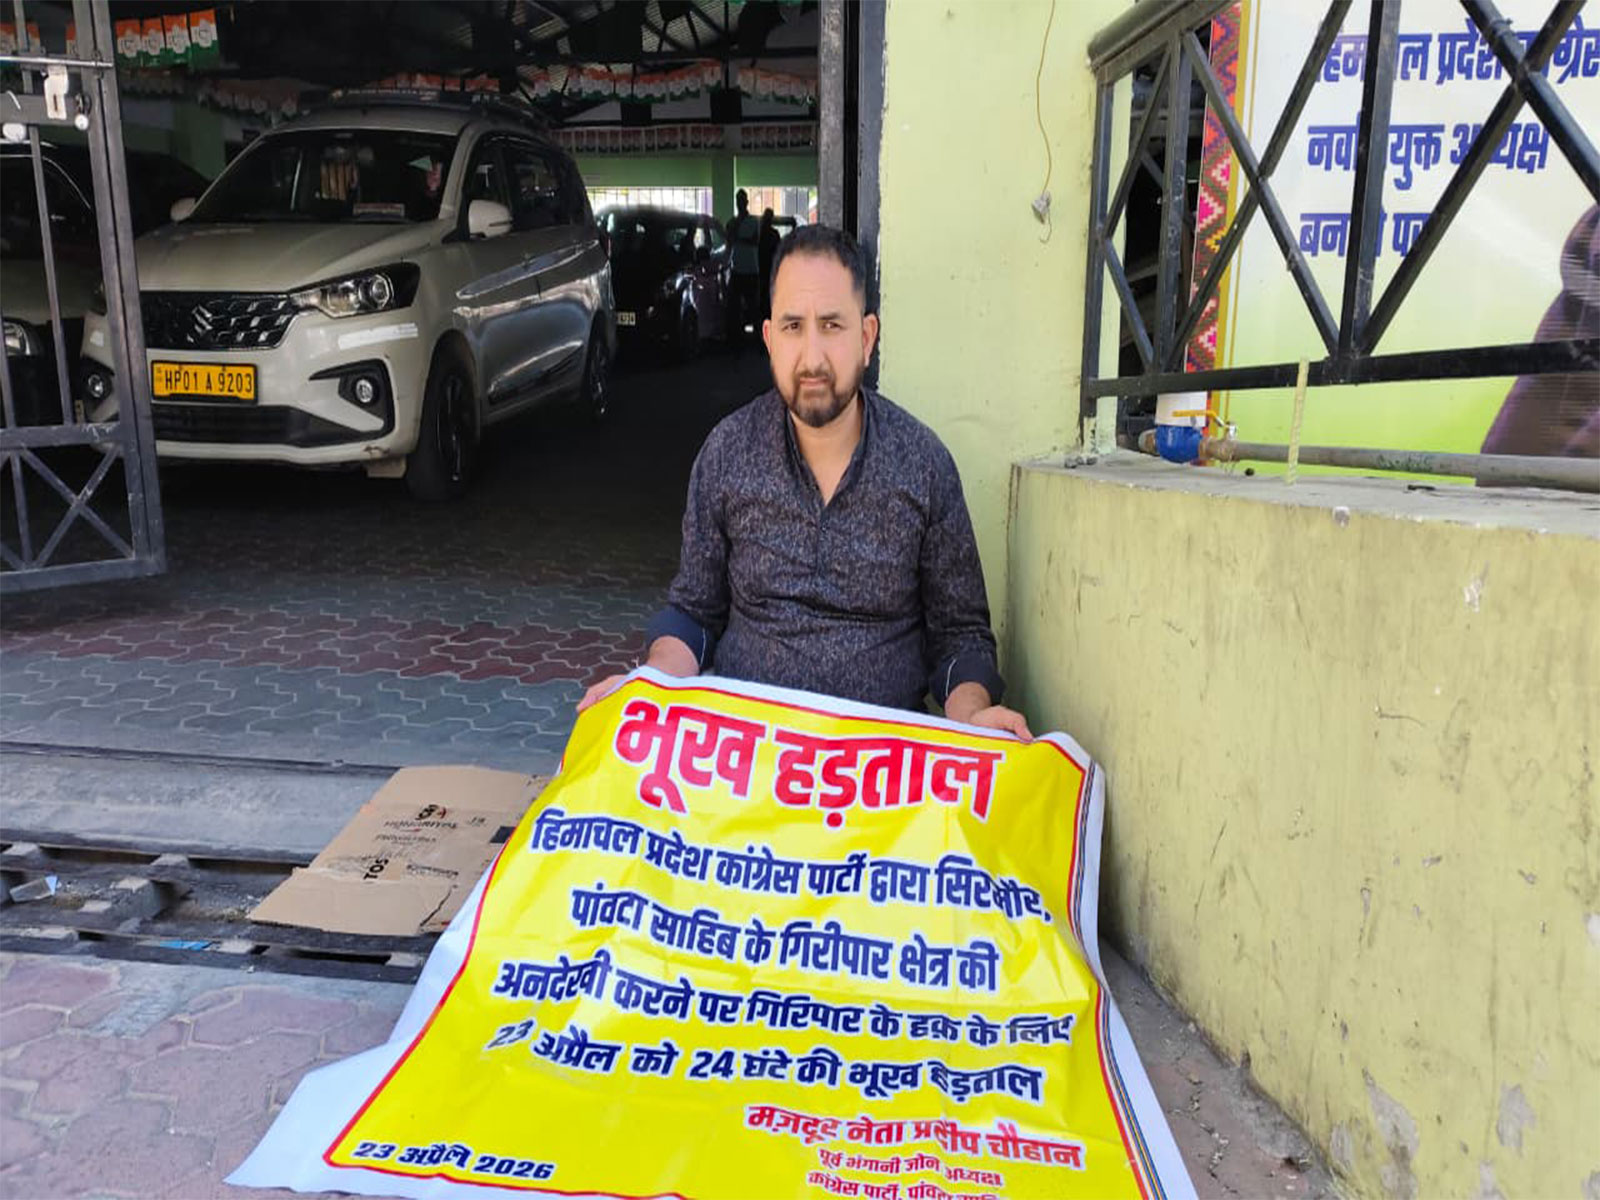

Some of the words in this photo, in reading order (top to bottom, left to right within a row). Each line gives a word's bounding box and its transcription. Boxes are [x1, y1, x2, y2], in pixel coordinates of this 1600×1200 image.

[165, 369, 198, 391] HP01
[206, 371, 213, 392] A
[218, 372, 253, 393] 9203
[615, 701, 766, 814] भूख
[774, 729, 1003, 827] हड़ताल
[531, 808, 644, 855] हिमाचल
[645, 830, 713, 881] प्रदेश
[715, 846, 804, 894] कांग्रेस
[807, 853, 867, 895] पार्टी
[869, 859, 930, 903] द्वारा
[571, 881, 649, 931] पांवटा
[651, 909, 741, 960] साहिब
[744, 918, 776, 964] के
[780, 921, 893, 979] गिरीपार
[899, 933, 953, 987] क्षेत्र
[956, 941, 999, 991] की
[493, 949, 612, 1002] अनदेखी
[614, 968, 694, 1020] करने
[699, 990, 742, 1022] पर
[747, 990, 865, 1033] गिरिपार
[870, 1004, 902, 1038] के
[967, 1014, 999, 1047] के
[1006, 1015, 1073, 1046] लिए
[487, 1020, 534, 1049] 23
[534, 1025, 622, 1073] अप्रैल
[632, 1042, 679, 1075] को
[690, 1050, 736, 1079] 24
[744, 1050, 793, 1080] घंटे
[799, 1048, 842, 1085] की
[849, 1062, 922, 1097] भूख
[353, 1142, 396, 1159] 23
[474, 1155, 554, 1179] 2026
[819, 1148, 843, 1169] पूर्व
[847, 1116, 903, 1144] नेता
[985, 1121, 1082, 1168] चौहान
[808, 1171, 859, 1196] कांग्रेस
